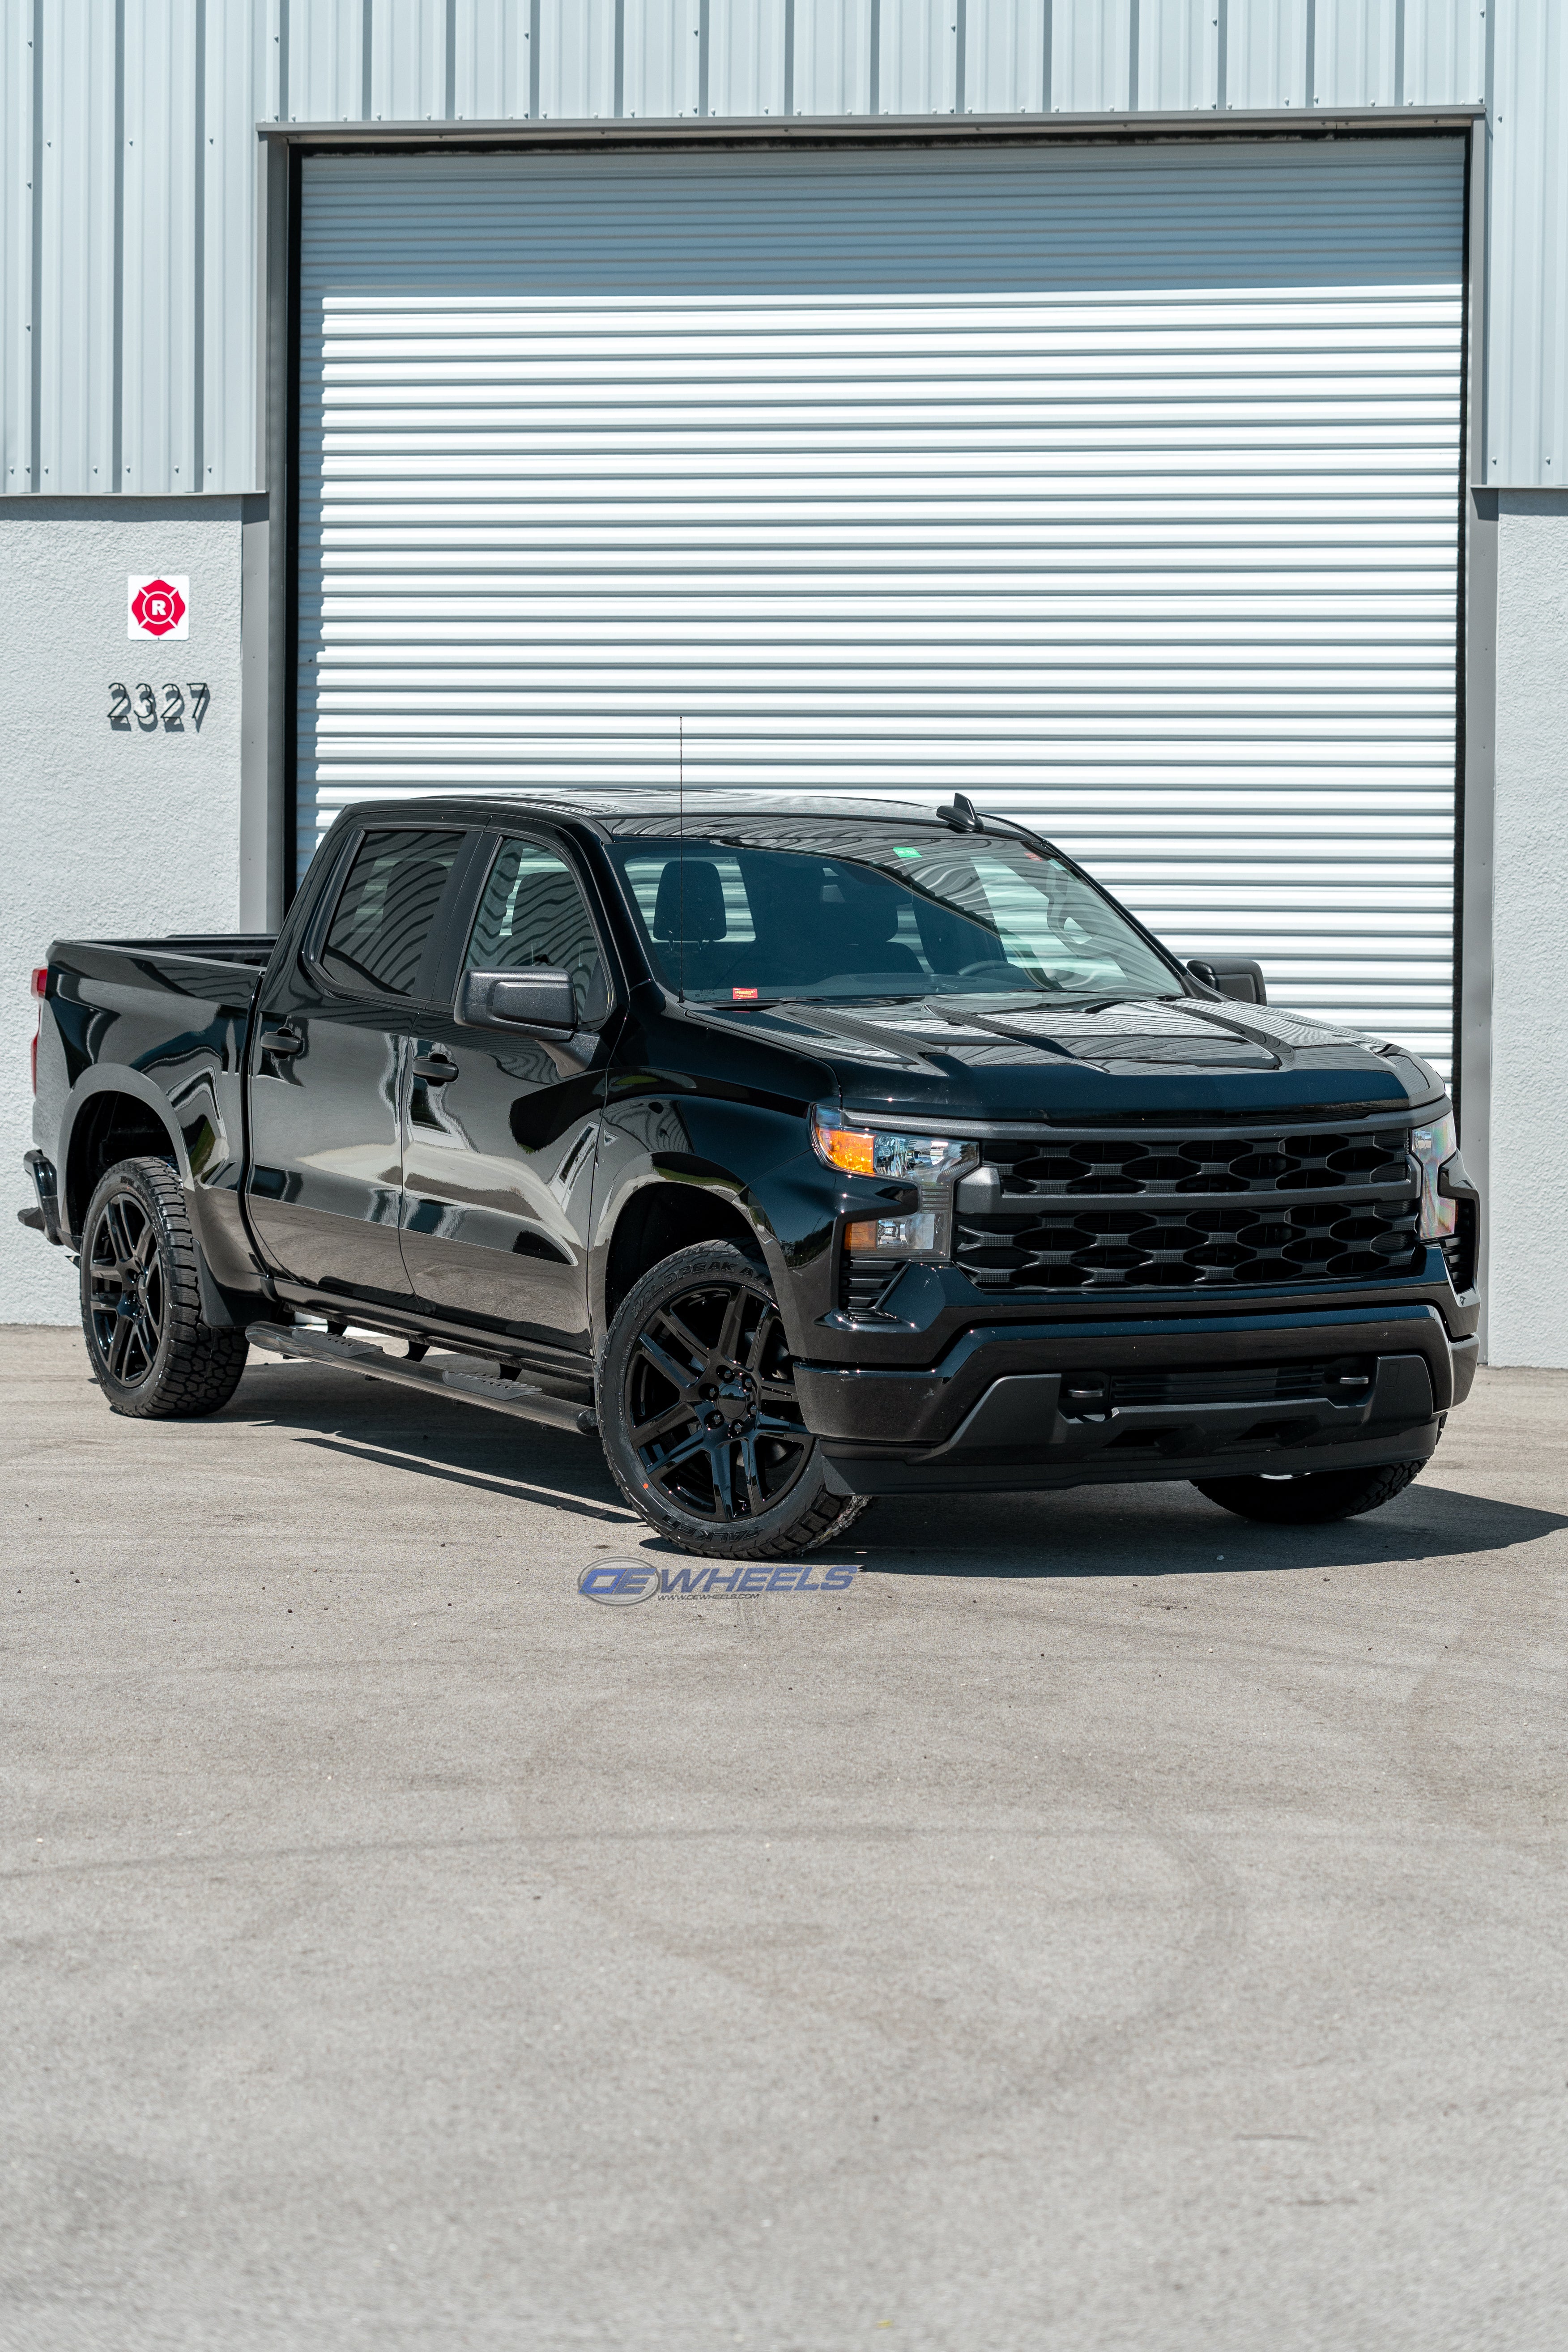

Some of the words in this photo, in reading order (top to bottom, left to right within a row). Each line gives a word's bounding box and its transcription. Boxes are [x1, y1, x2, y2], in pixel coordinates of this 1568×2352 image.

[151, 599, 166, 616] R
[107, 682, 210, 733] 2327
[631, 1261, 738, 1319] WILDPEAK
[662, 1513, 764, 1542] FALKEN
